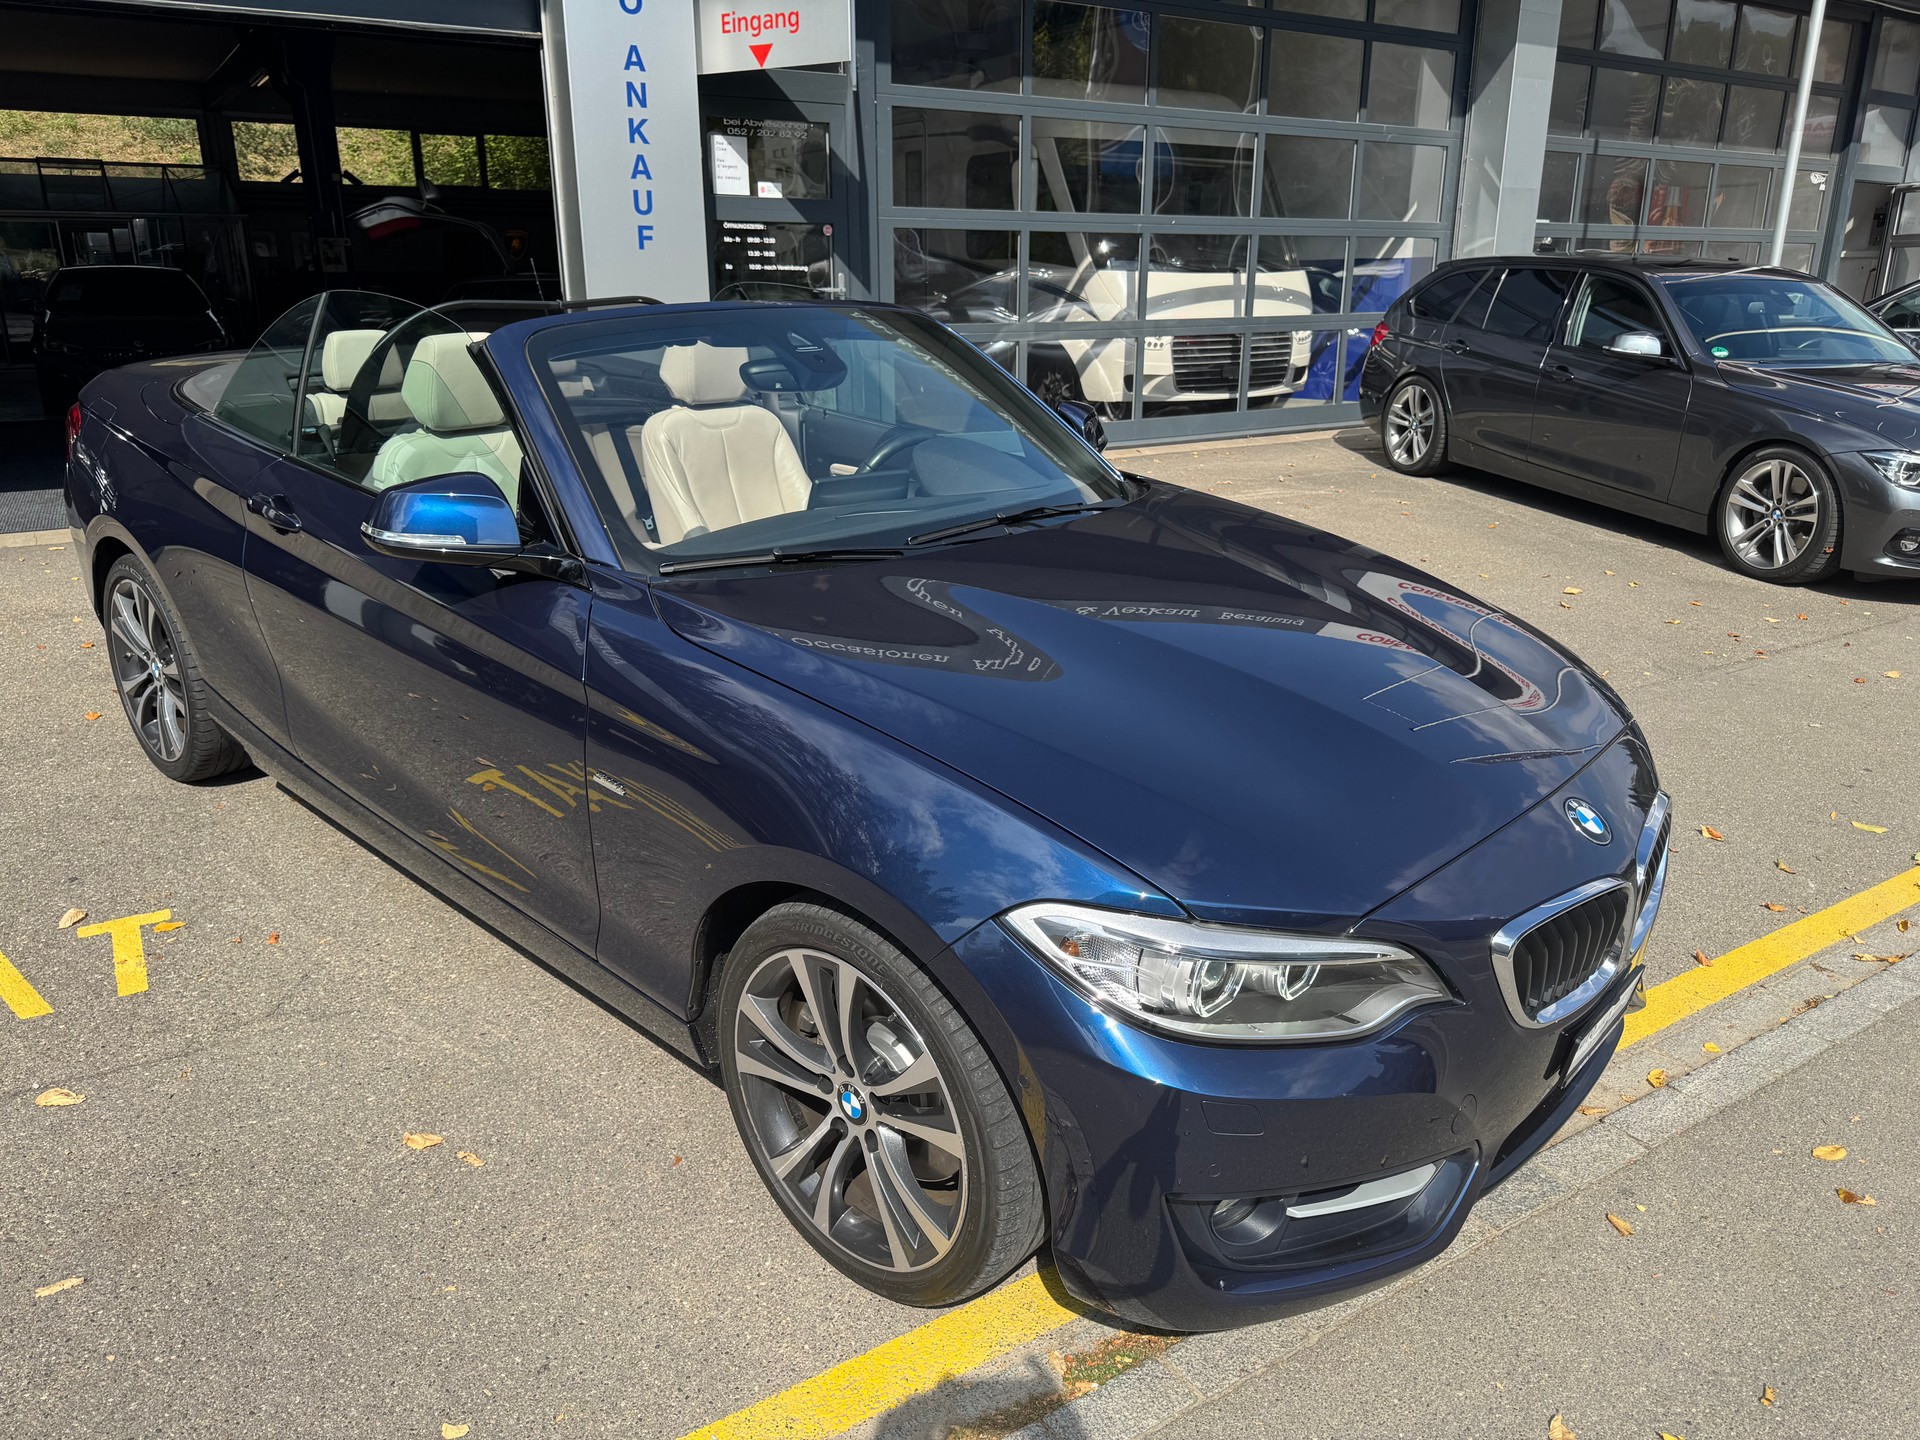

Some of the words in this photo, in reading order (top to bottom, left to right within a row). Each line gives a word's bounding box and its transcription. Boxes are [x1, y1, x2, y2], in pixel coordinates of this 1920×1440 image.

[721, 9, 800, 37] Eingang
[723, 118, 741, 126] bei
[727, 127, 748, 135] 052
[757, 129, 776, 137] 202
[794, 131, 808, 140] 92
[623, 44, 654, 250] ANKAUF
[791, 921, 889, 973] BRIDGESTONE
